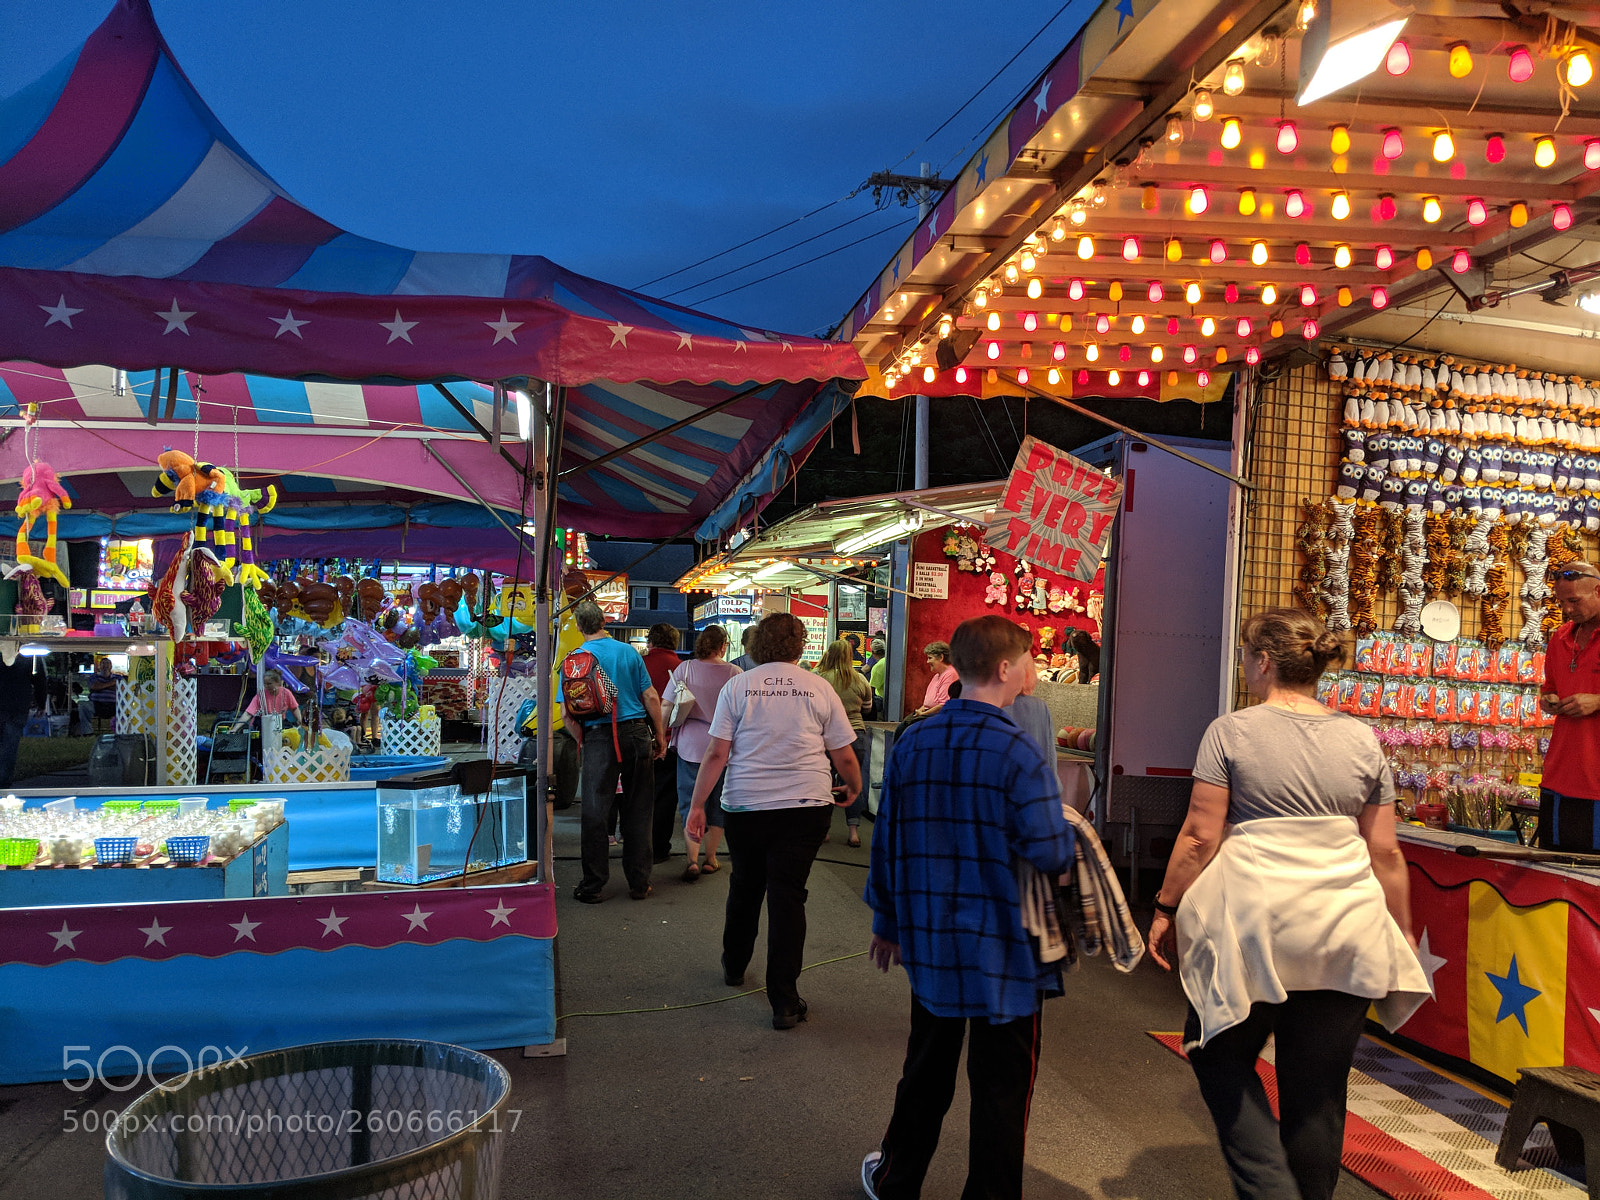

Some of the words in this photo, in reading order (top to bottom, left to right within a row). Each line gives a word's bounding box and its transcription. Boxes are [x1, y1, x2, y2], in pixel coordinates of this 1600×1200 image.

[1026, 442, 1118, 504] PRIZE
[1003, 469, 1113, 545] EVERY
[1006, 516, 1082, 573] TIME
[763, 677, 796, 686] C.H.S.
